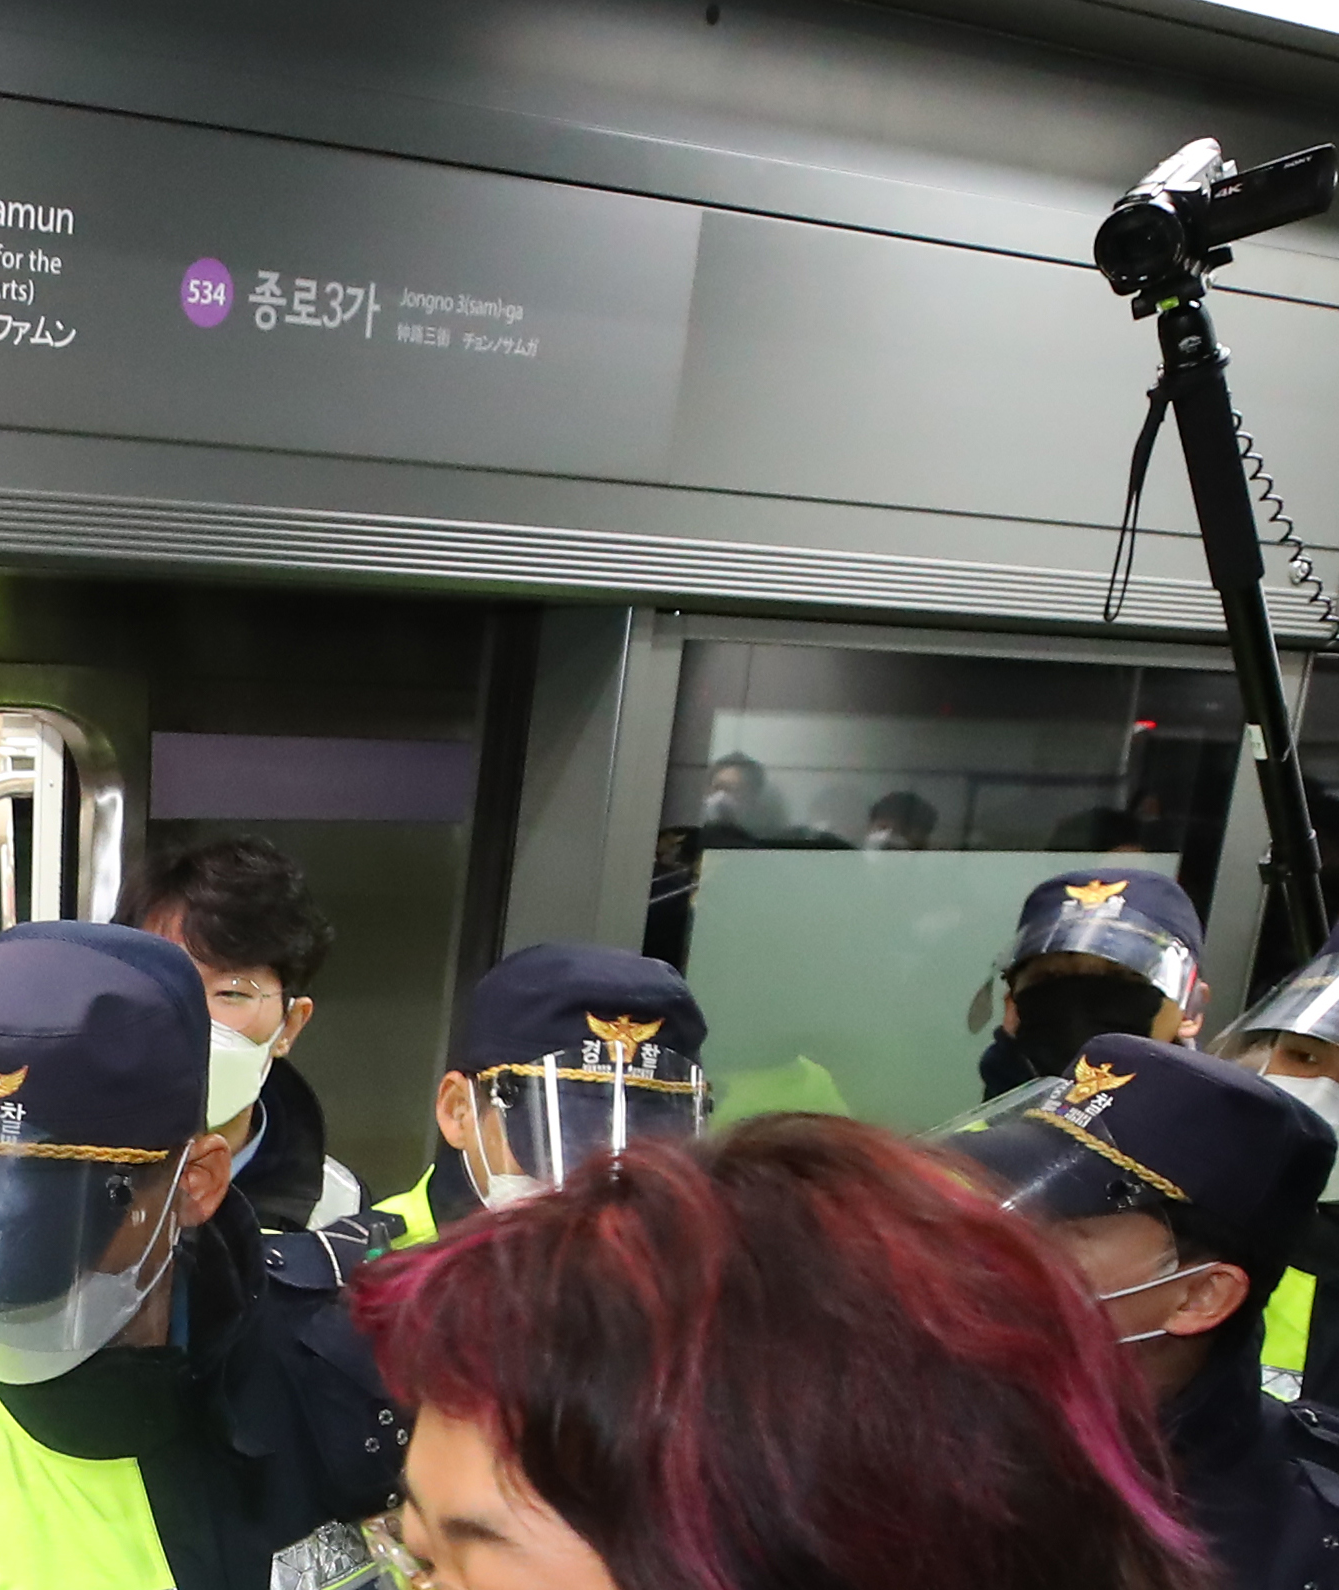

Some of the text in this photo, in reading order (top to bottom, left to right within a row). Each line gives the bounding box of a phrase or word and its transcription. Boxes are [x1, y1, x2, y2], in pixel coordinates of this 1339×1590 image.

[1214, 183, 1244, 199] 4K
[28, 246, 62, 275] the
[187, 280, 226, 306] 534
[248, 270, 381, 339] 종로3가
[400, 288, 454, 315] Jongno
